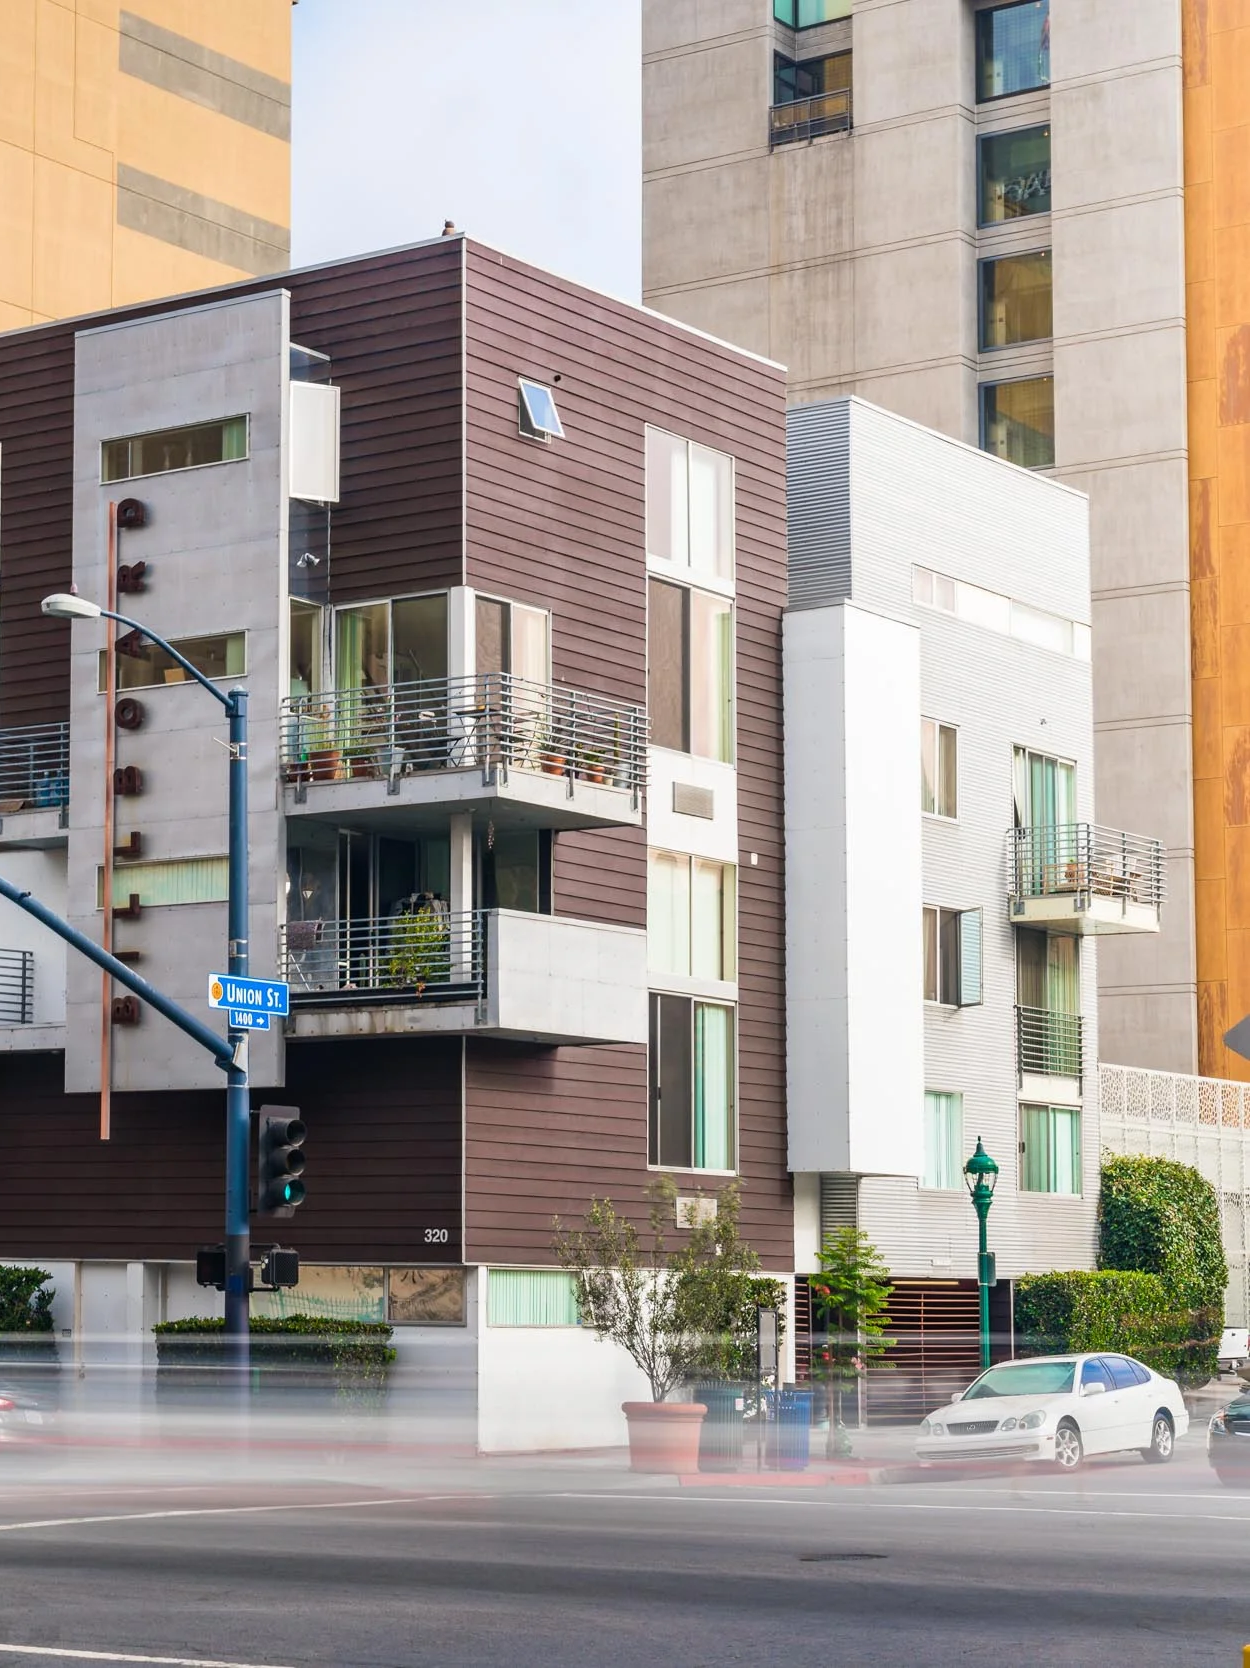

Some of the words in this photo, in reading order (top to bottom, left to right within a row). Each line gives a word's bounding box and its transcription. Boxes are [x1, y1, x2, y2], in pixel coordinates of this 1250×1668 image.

[111, 497, 146, 1025] BILLBOARD
[226, 983, 262, 1006] UNION
[267, 987, 282, 1008] ST.
[234, 1011, 253, 1026] 1400
[424, 1228, 449, 1243] 320
